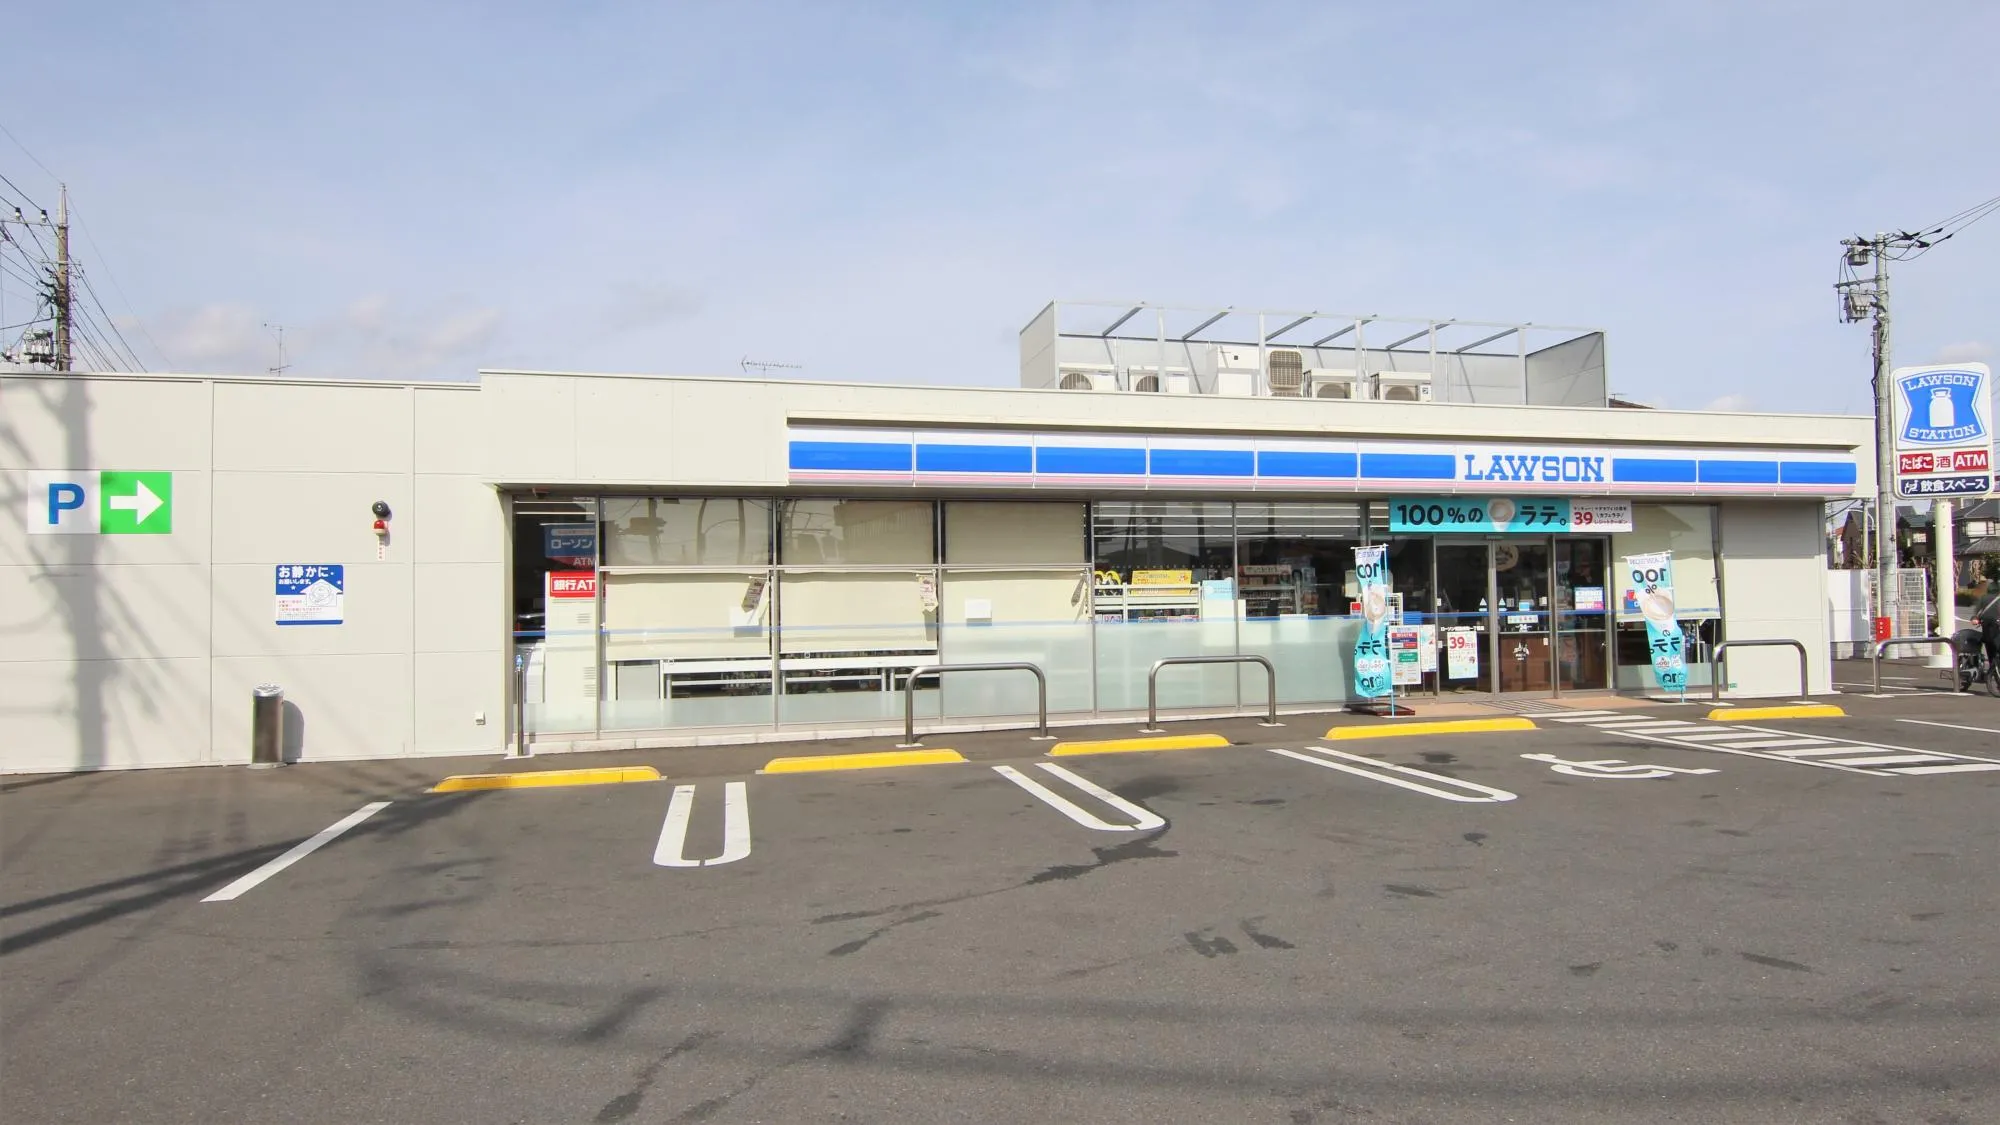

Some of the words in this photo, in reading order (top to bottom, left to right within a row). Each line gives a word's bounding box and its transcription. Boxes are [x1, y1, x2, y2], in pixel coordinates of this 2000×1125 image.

[1906, 375, 1975, 391] LAWSON
[1909, 425, 1976, 440] STATION
[1464, 454, 1604, 482] LAWSON
[1901, 456, 1932, 470] たばこ
[1936, 456, 1950, 468] 酒
[1955, 454, 1986, 467] ATM
[1921, 479, 1985, 492] 飲食スペース
[48, 483, 85, 524] P
[1574, 511, 1593, 525] 39
[553, 580, 596, 591] 銀行AT
